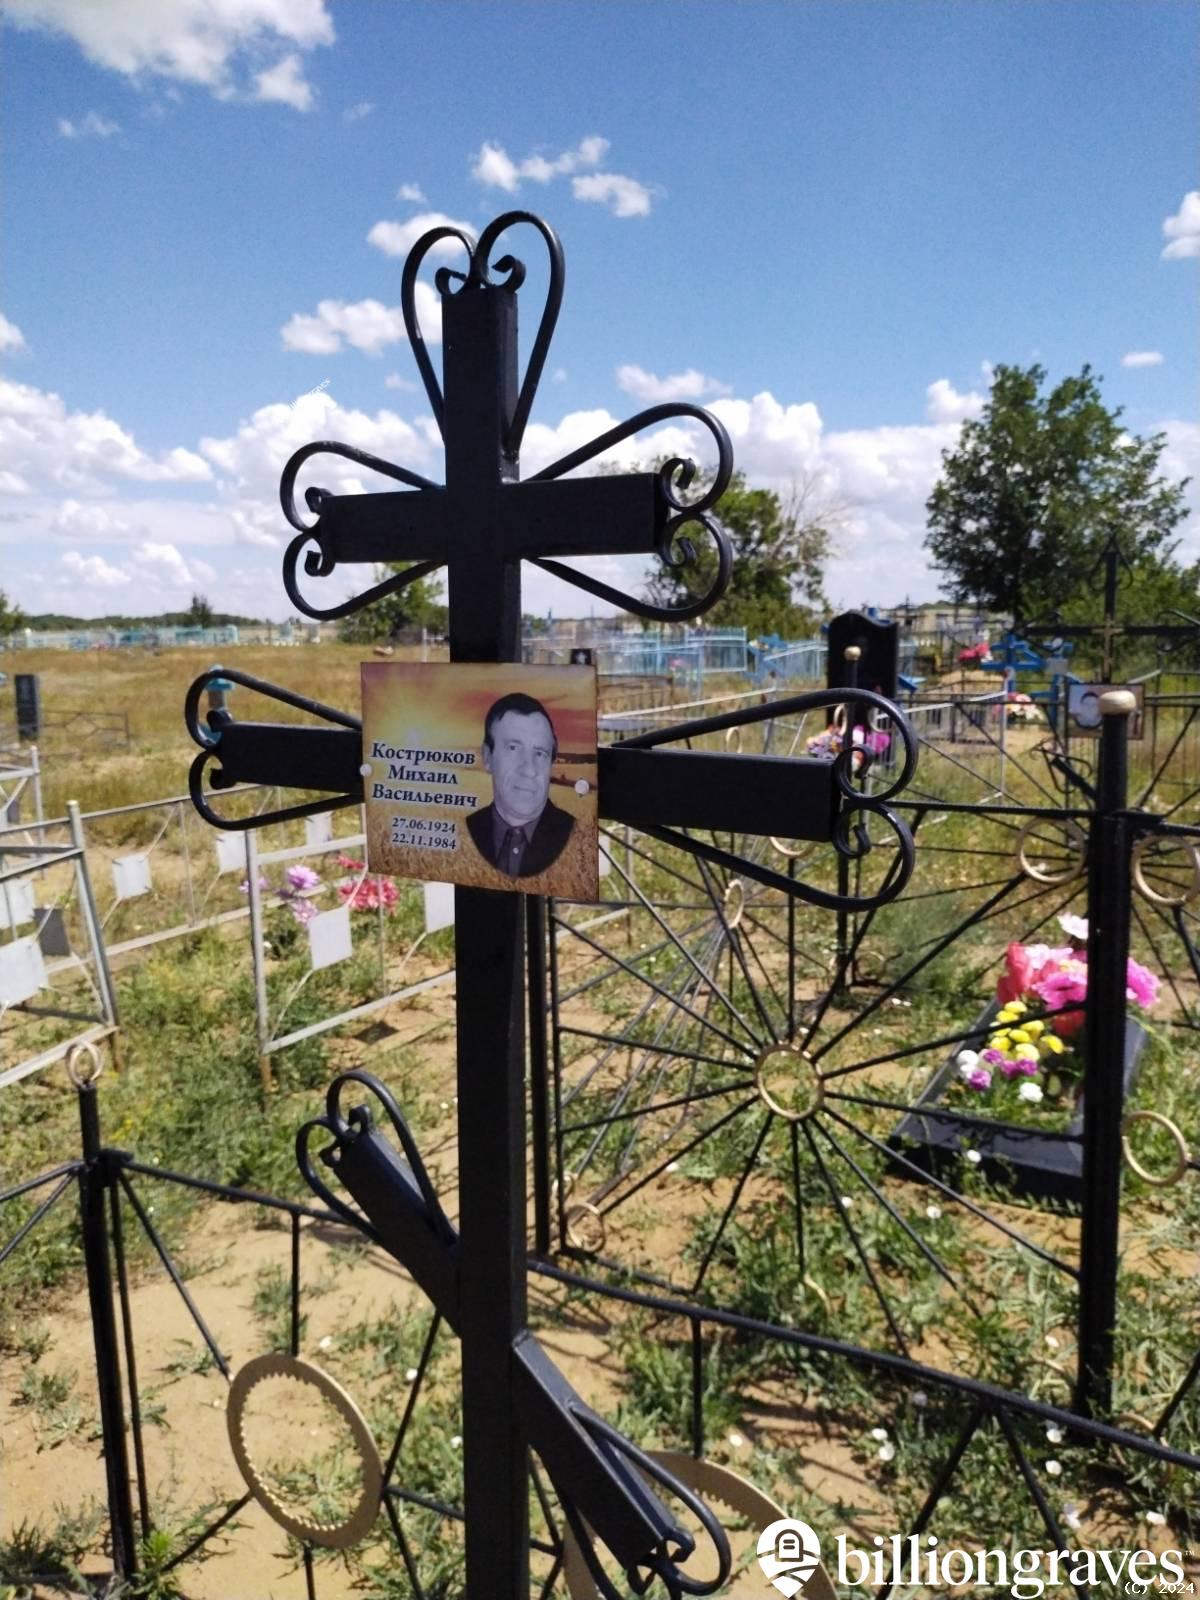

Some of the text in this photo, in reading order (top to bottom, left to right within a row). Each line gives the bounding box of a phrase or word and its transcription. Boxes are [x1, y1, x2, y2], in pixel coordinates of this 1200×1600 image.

[372, 742, 475, 765] Кострюков
[388, 764, 458, 784] Михаил
[372, 783, 478, 807] Васильевич
[392, 817, 456, 834] 27.06.1924
[392, 833, 456, 849] 22.11.1984
